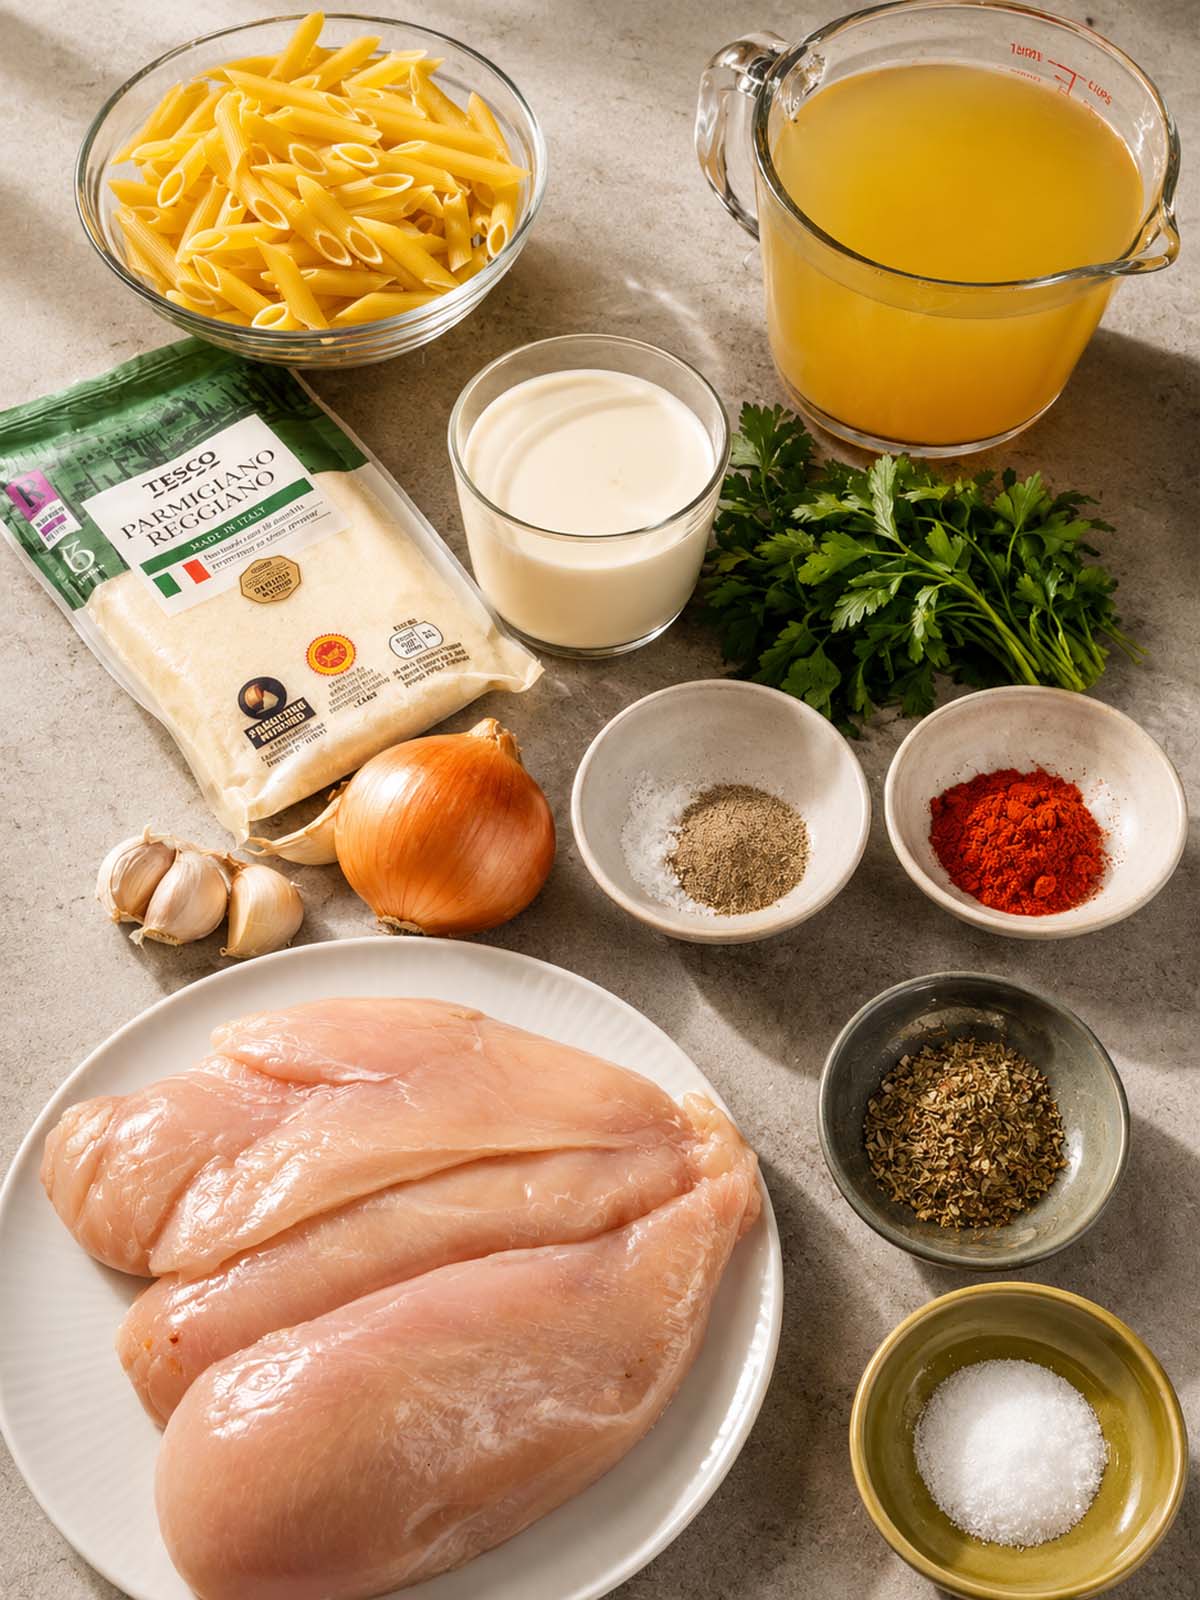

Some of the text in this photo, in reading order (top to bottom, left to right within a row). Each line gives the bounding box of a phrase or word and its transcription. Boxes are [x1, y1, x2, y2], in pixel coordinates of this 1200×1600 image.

[121, 450, 275, 540] PARMIGIANO
[142, 451, 217, 495] TESCO
[146, 471, 275, 547] REGGIANO
[190, 532, 222, 551] MADE
[239, 506, 267, 528] ITALY
